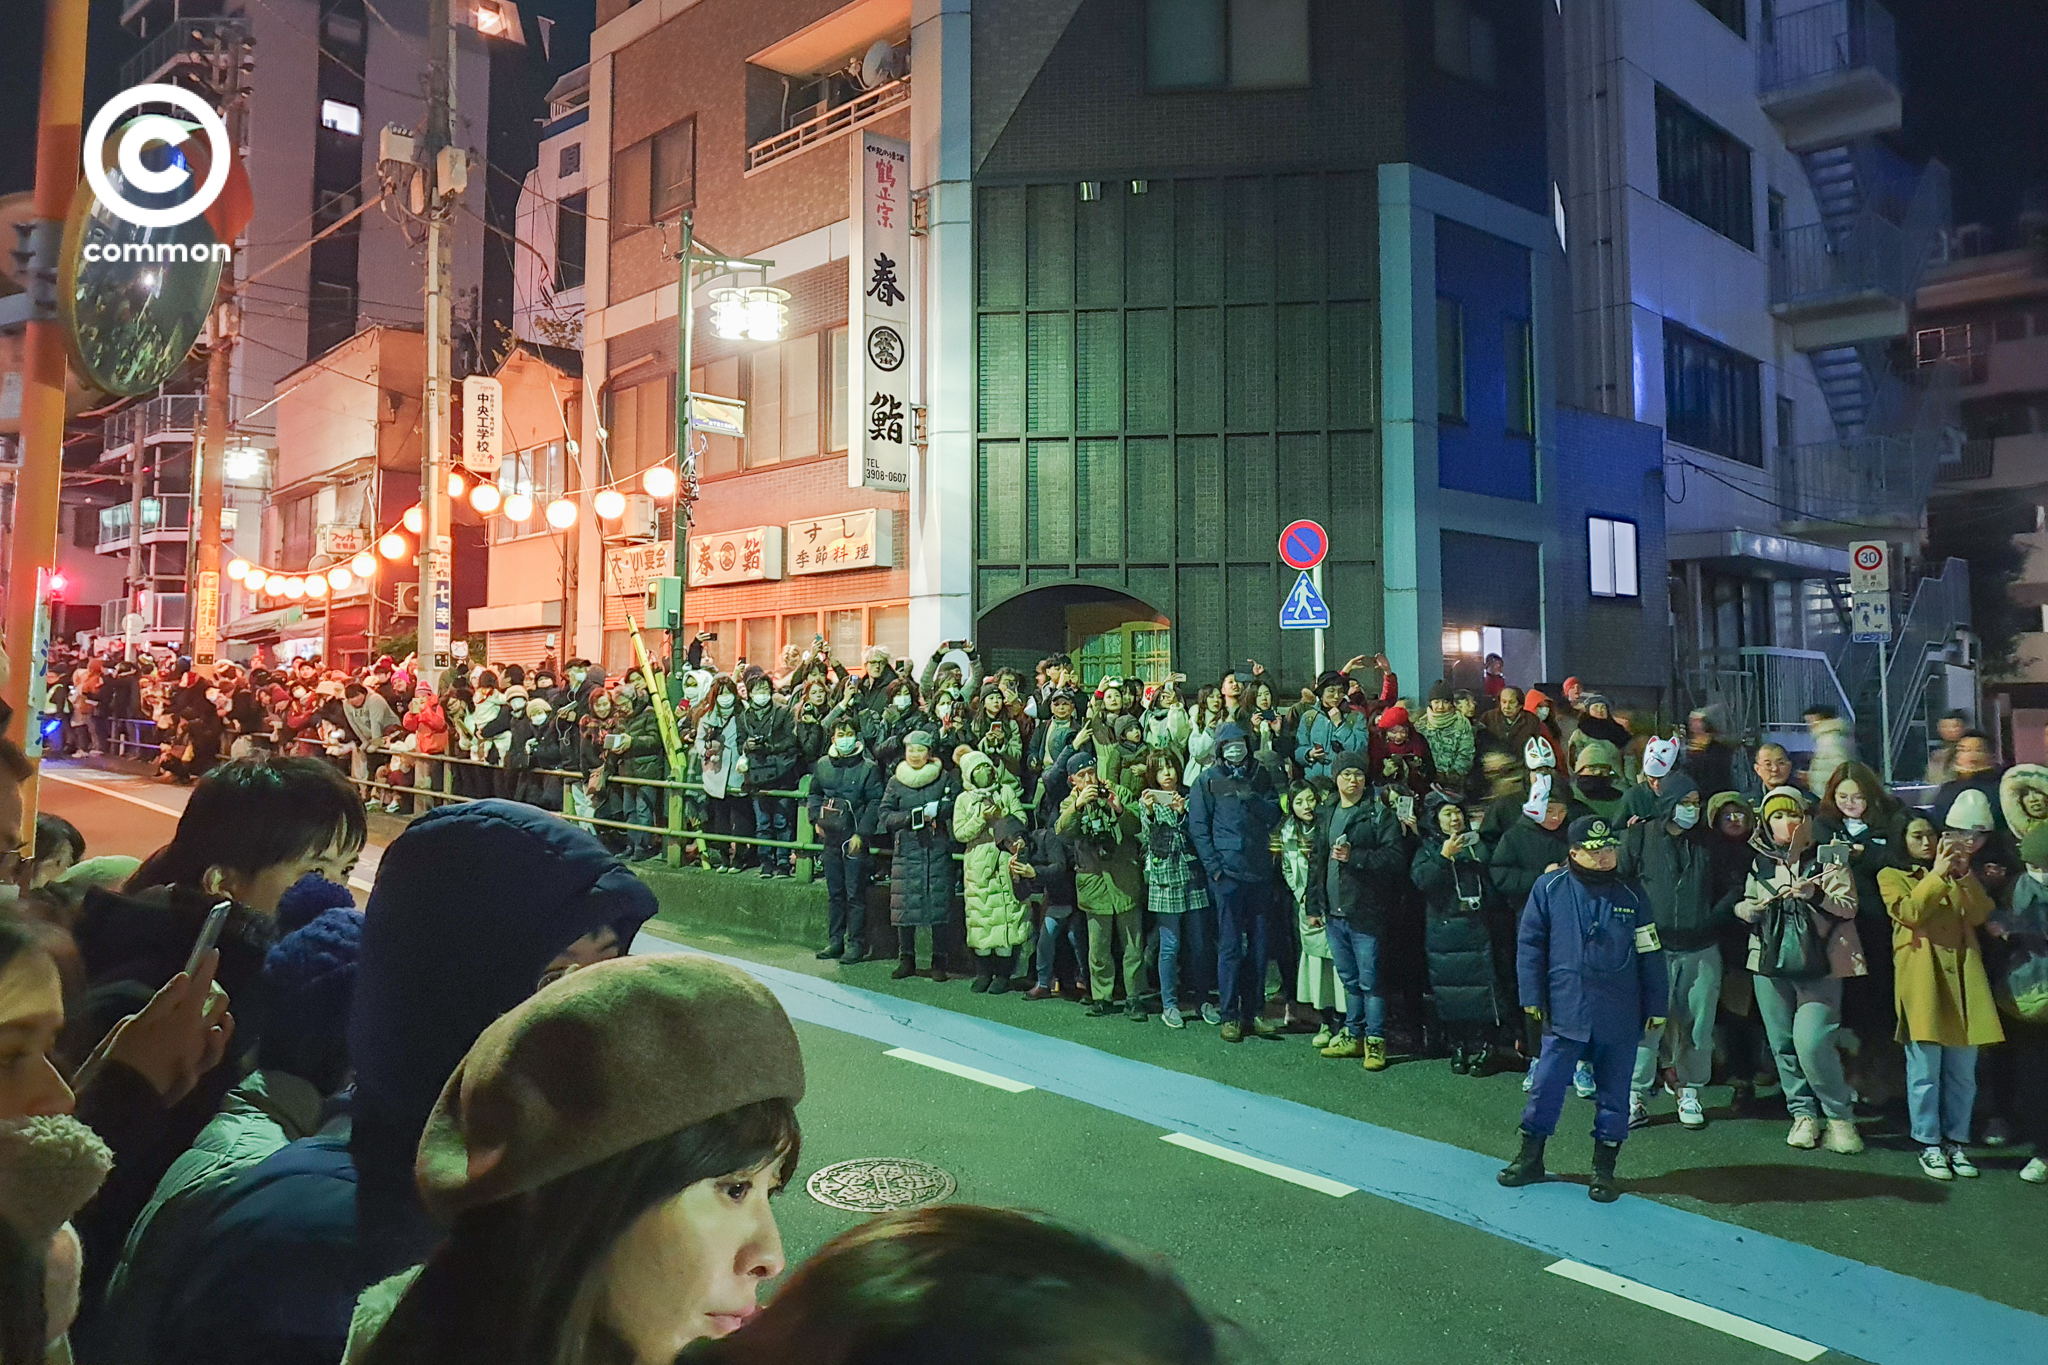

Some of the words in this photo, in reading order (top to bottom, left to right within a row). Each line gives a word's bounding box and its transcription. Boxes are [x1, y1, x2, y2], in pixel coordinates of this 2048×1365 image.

[875, 158, 897, 229] 鶴正宗
[866, 252, 905, 307] 春
[476, 393, 490, 453] 中央工学校
[868, 391, 904, 444] 鮨
[866, 469, 907, 483] 3908-0607
[867, 458, 880, 469] TEL
[803, 518, 855, 545] すし
[611, 547, 667, 574] 大・小宴会
[695, 543, 714, 577] 春
[742, 538, 760, 573] 鮨
[796, 543, 870, 569] 季節料理
[1860, 552, 1877, 564] 30
[436, 584, 450, 625] 七幸
